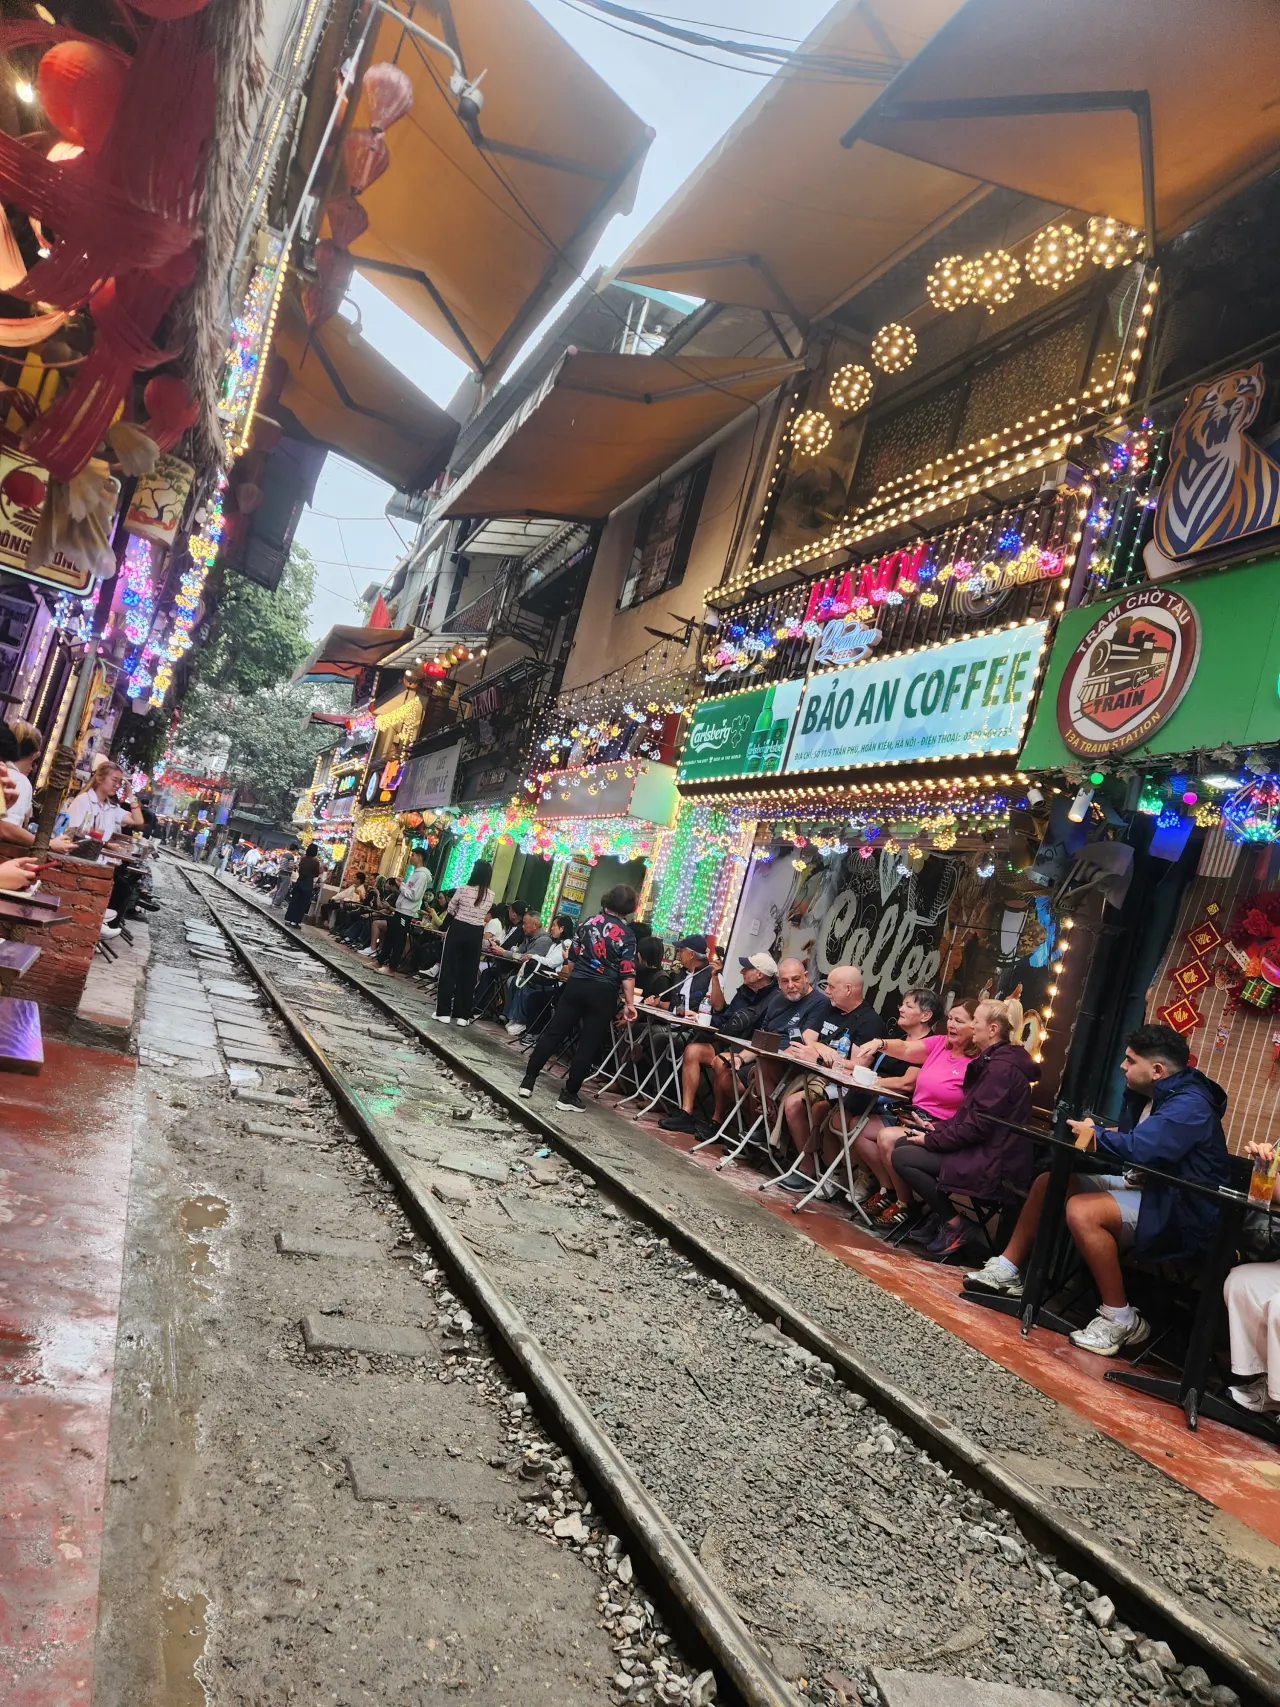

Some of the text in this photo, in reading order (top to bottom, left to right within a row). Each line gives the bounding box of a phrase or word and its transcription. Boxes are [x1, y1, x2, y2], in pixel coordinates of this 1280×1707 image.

[803, 543, 925, 625] HANOI
[815, 619, 878, 657] Premium
[1076, 589, 1191, 655] TRẠM CHỜ TÀU
[832, 649, 853, 660] BEER
[801, 651, 1032, 735] BẢO AN COFFEE
[1092, 690, 1145, 714] TRAIN
[690, 719, 732, 753] Carlsberg
[895, 738, 904, 748] HÀ
[905, 737, 917, 749] NỘI
[1065, 711, 1162, 753] 13A TRAIN STATION
[818, 889, 941, 1015] Coffee
